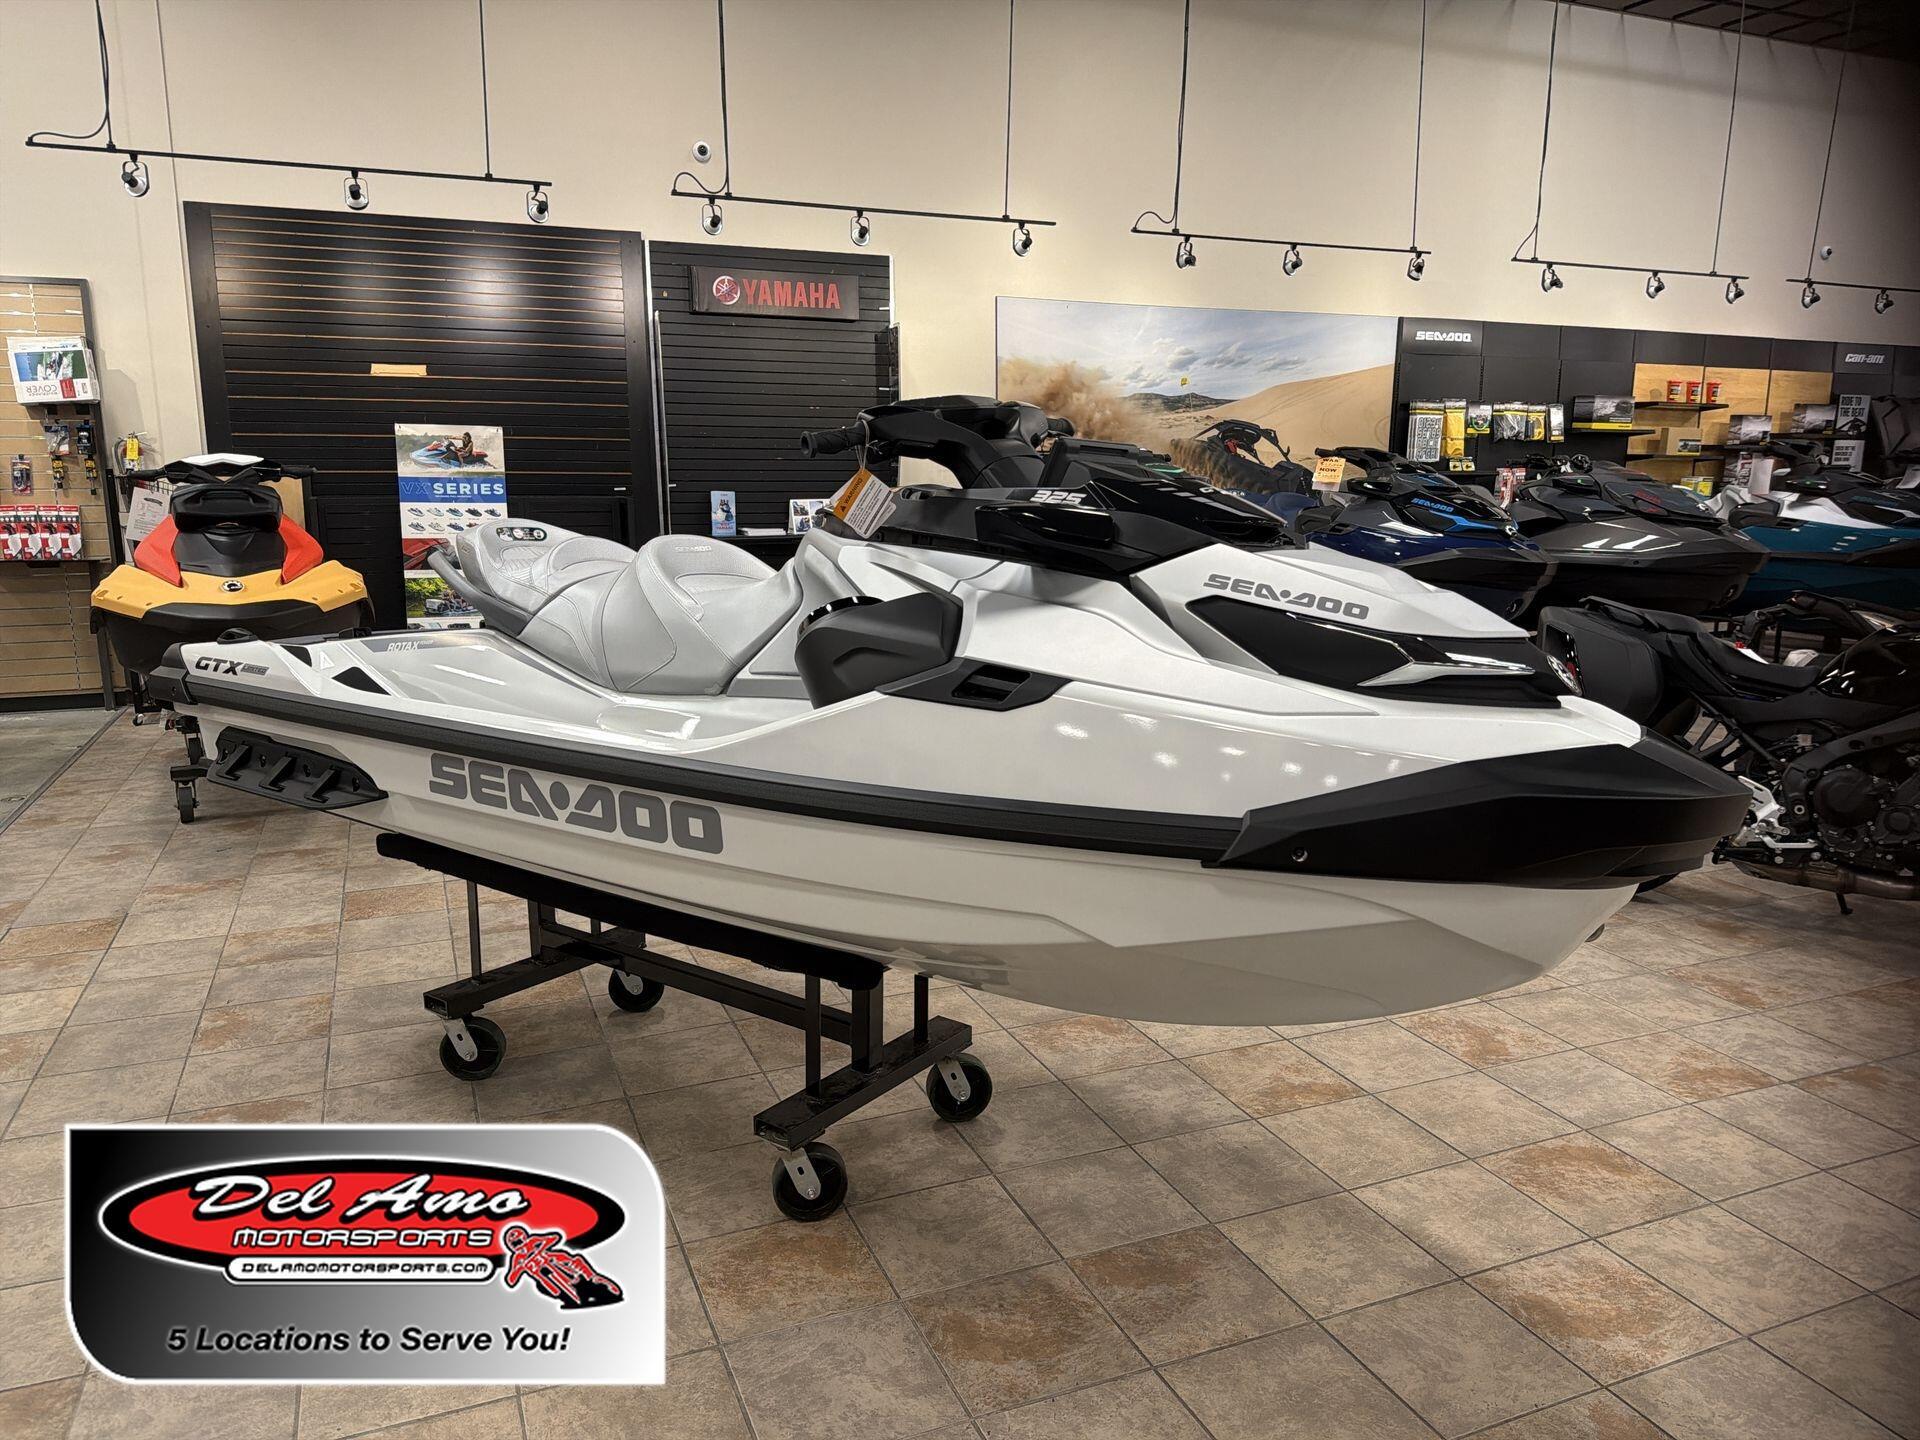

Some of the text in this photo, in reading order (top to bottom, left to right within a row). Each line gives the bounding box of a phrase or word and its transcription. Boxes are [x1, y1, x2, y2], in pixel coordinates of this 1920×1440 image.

[742, 278, 841, 310] YAMAHA
[433, 482, 504, 495] SERIES
[844, 477, 863, 504] WARNING
[1030, 490, 1087, 505] 325
[387, 641, 420, 652] ROTAX
[195, 656, 243, 676] GTX
